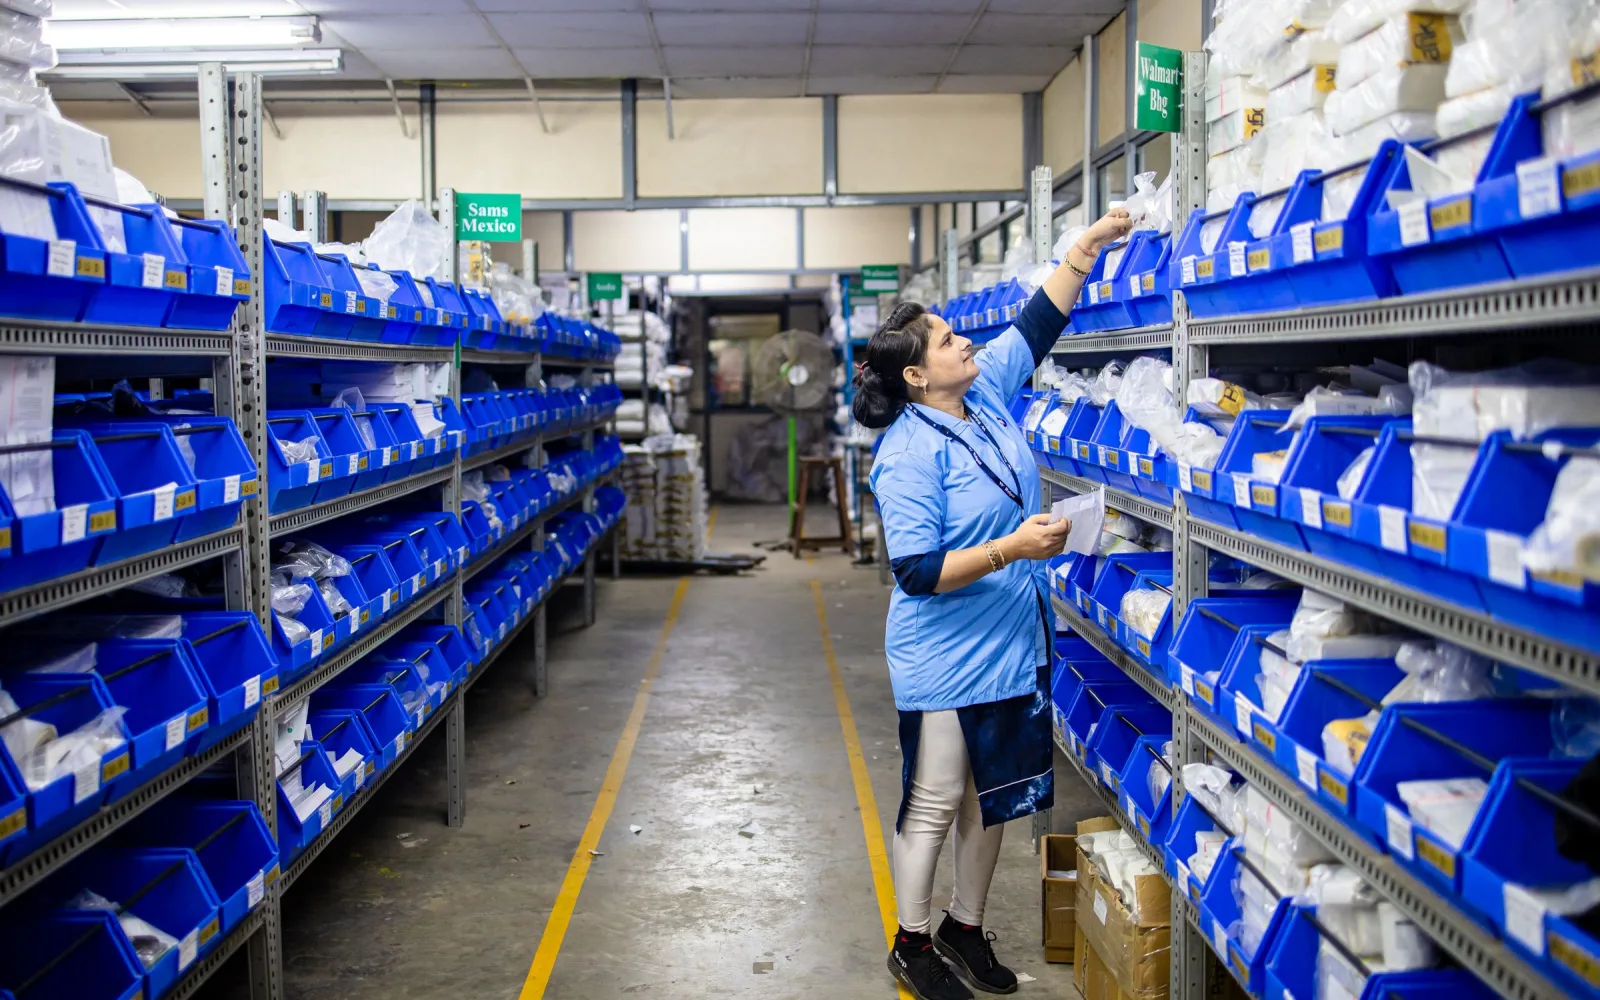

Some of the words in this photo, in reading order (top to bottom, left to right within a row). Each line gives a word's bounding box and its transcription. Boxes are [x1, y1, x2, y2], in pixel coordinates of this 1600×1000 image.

[1140, 56, 1179, 85] Walmart
[1150, 88, 1168, 118] Bhg
[468, 202, 509, 217] Sams
[462, 218, 516, 233] Mexico
